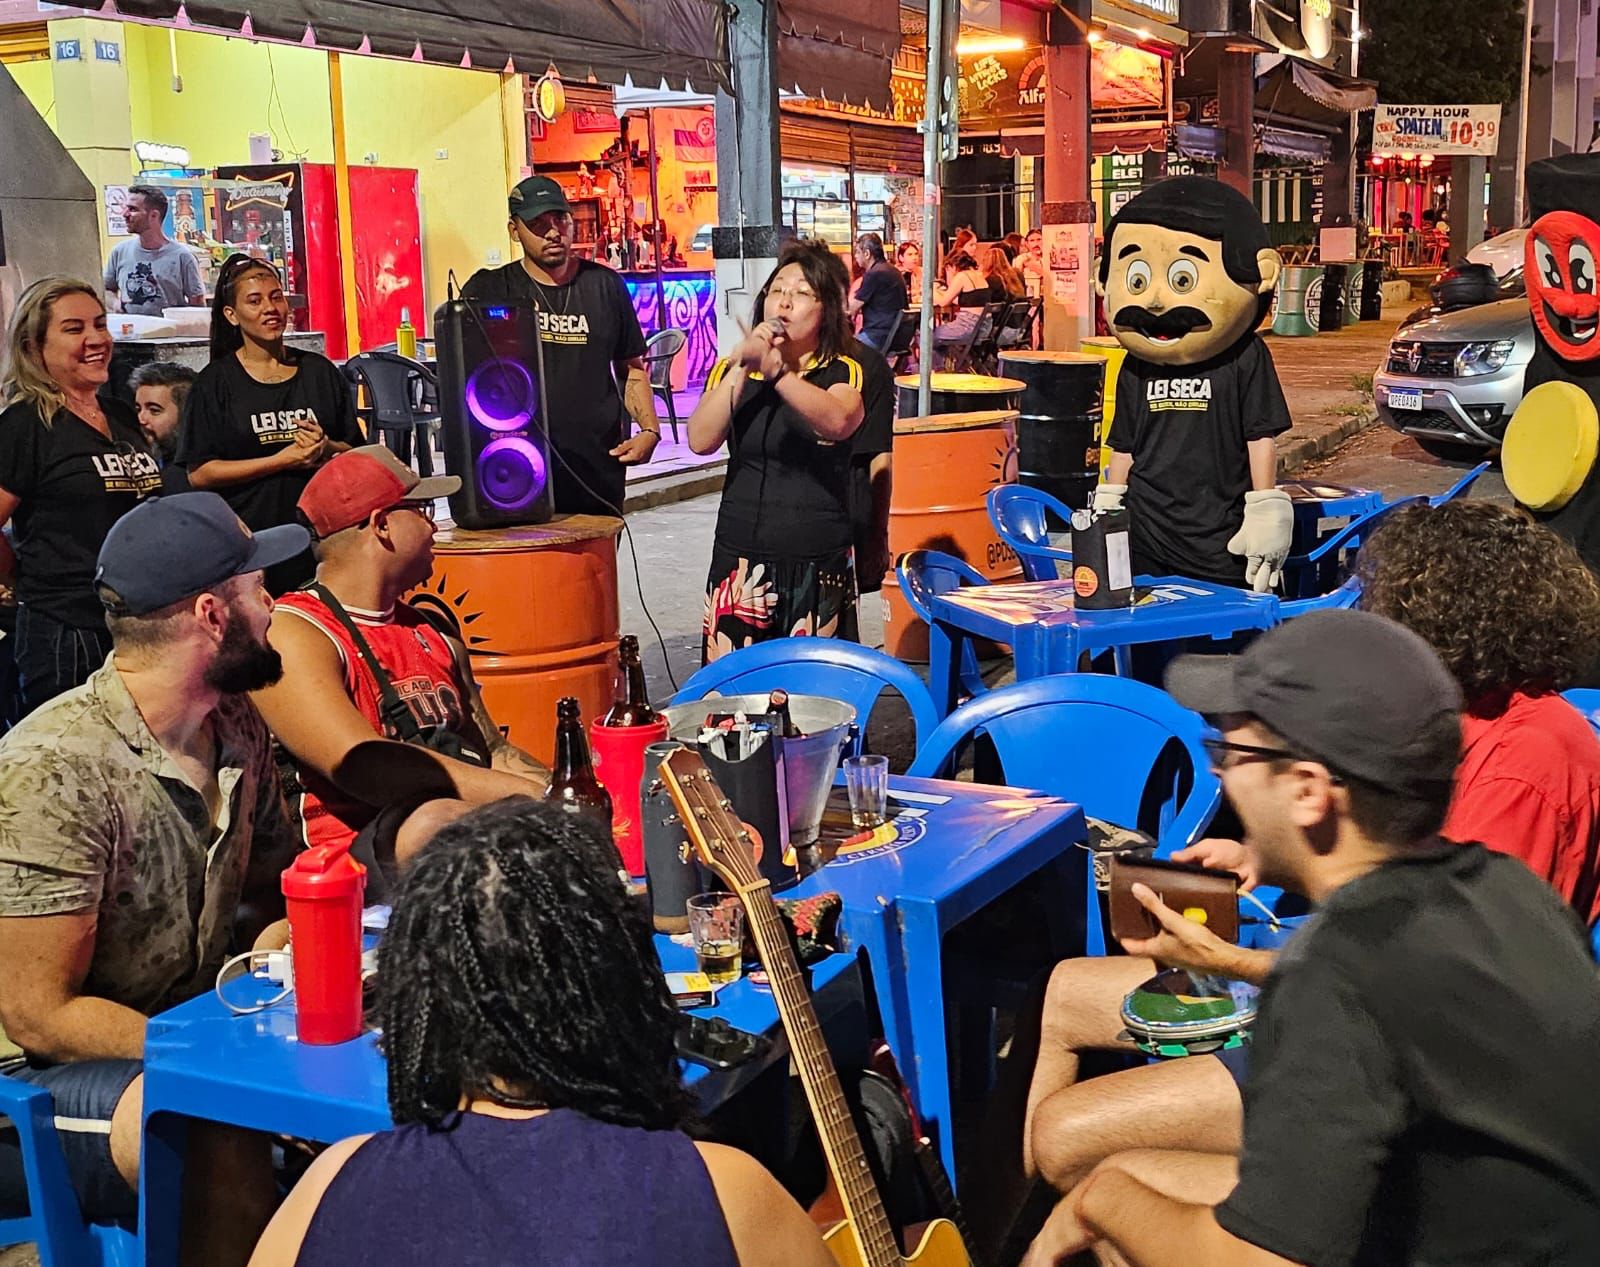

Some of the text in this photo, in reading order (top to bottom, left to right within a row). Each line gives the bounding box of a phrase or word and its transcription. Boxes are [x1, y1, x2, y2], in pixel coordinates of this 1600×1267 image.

[60, 41, 75, 57] 16
[101, 43, 116, 59] 16
[1387, 106, 1470, 118] HAPPY HOUR
[1395, 117, 1442, 136] SPATEN
[549, 314, 590, 334] SECA
[1146, 378, 1212, 401] LEI SECA
[250, 411, 278, 434] LEI
[91, 453, 125, 478] LEI
